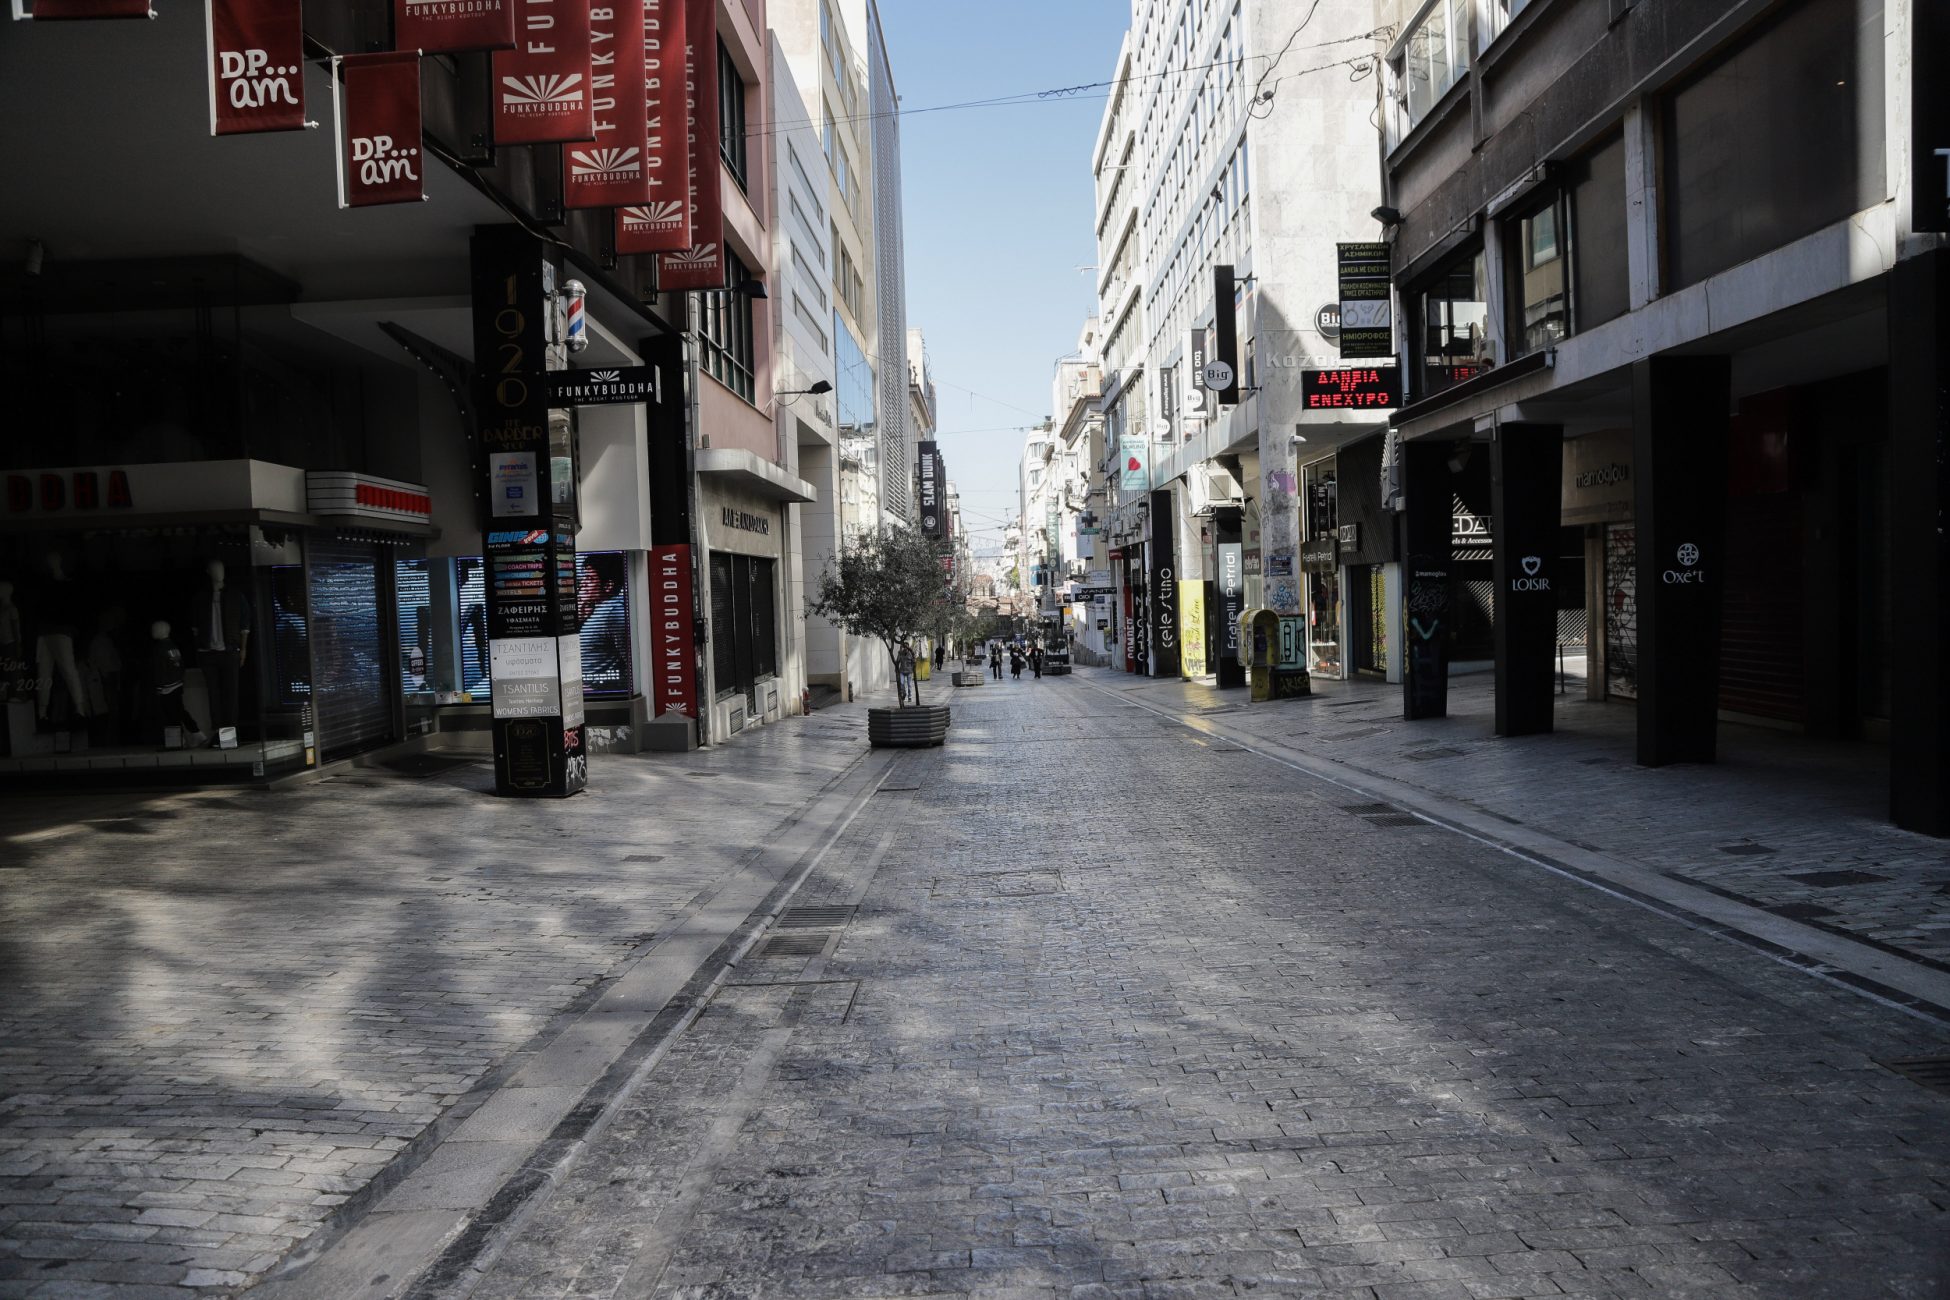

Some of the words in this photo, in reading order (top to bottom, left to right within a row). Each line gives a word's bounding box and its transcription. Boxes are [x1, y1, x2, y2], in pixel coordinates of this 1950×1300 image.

[406, 1, 501, 16] FUNKYBUDDHA
[503, 102, 583, 114] FUNKYBUDDHA
[572, 172, 640, 183] FUNKYBUDDHA
[623, 222, 683, 232] FUNKYBUDDHA
[1343, 332, 1389, 340] ΗΜΙΟΡΟΦΟΣ
[1207, 370, 1228, 380] Big
[1318, 370, 1379, 384] ΔΑΝΕΙΑ
[558, 382, 653, 397] FUNKYBUDDHA
[1310, 392, 1389, 406] ΕΝΕΧΥΡΟ
[922, 453, 933, 479] DUNK
[922, 481, 935, 506] SLAM
[1225, 552, 1236, 598] Petridi
[1512, 577, 1551, 591] LOISIR
[497, 604, 548, 615] ΖΑΦΕΙΡΗΣ
[1158, 568, 1173, 648] celestino
[662, 553, 682, 696] FUNKYBUDDHA
[1226, 602, 1237, 649] Fratelli
[503, 682, 549, 694] TSANTILIS
